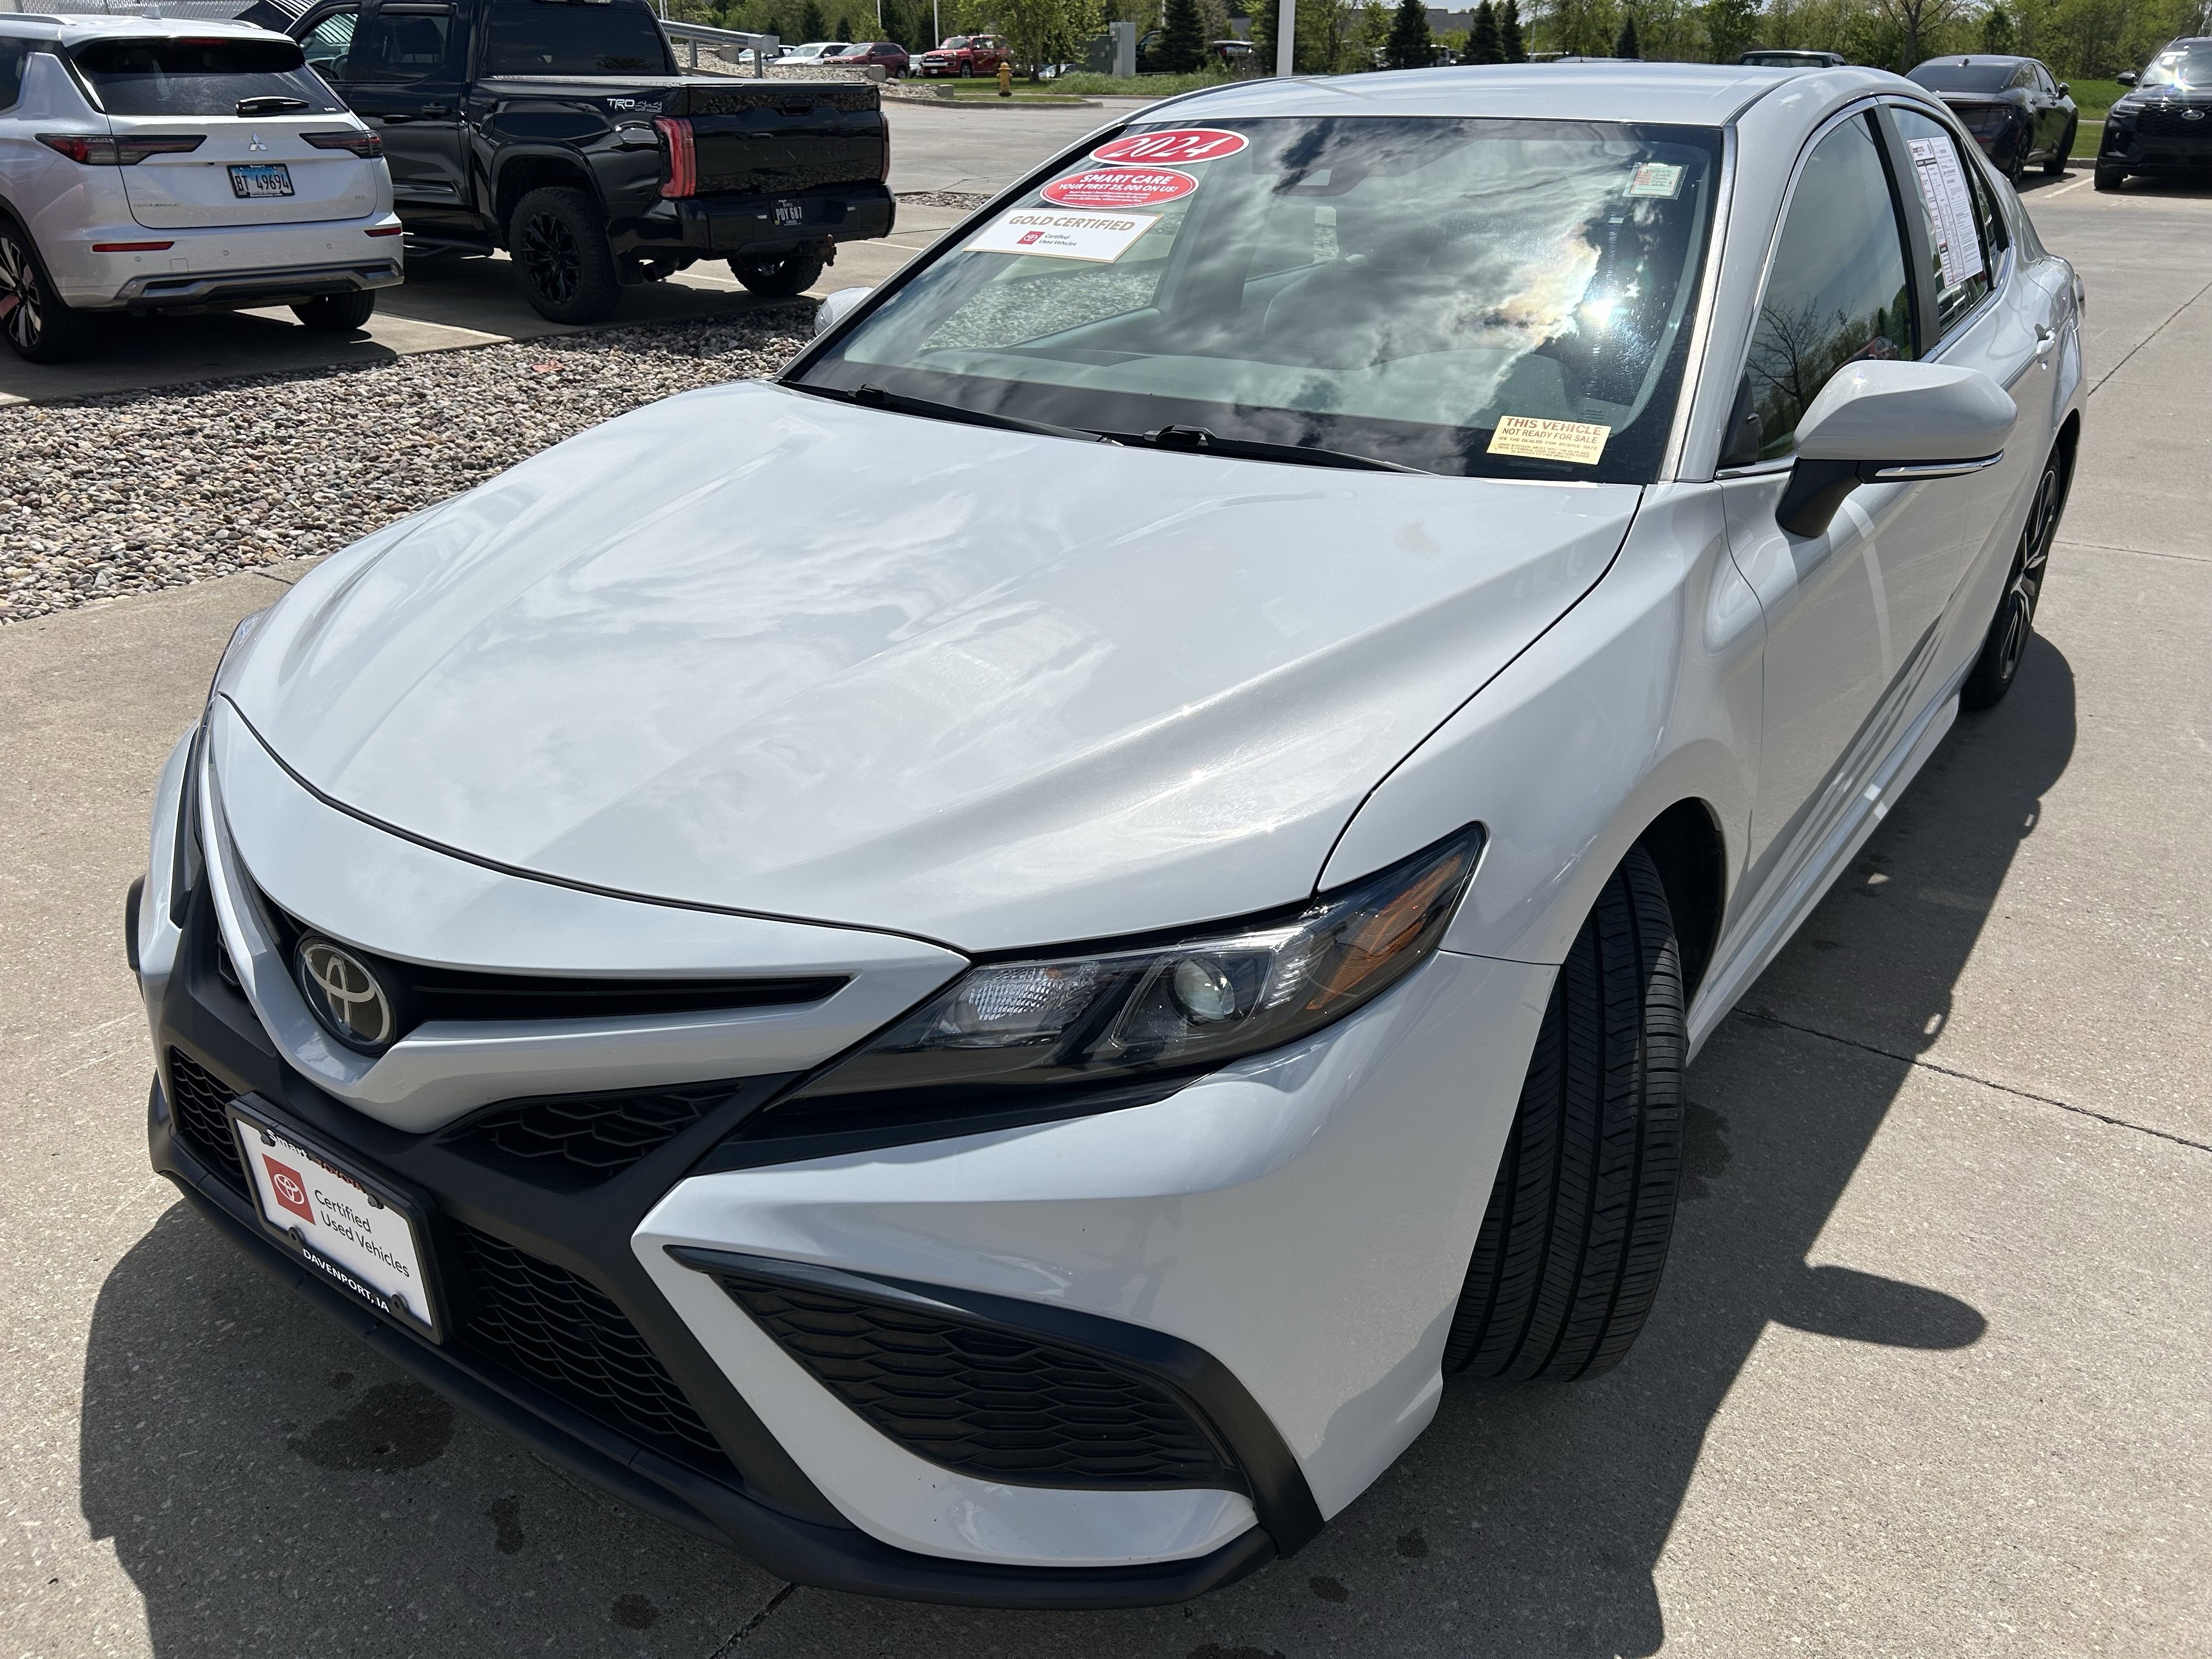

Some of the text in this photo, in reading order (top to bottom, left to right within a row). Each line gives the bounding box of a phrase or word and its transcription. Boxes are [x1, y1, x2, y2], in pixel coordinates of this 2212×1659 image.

[607, 98, 635, 109] TRD
[1102, 136, 1234, 157] 2024
[234, 174, 289, 191] BT 49694
[1080, 174, 1174, 184] SMART CARE
[789, 206, 802, 219] 687
[1009, 216, 1136, 231] GOLD CERTIFIED
[1507, 418, 1603, 436] THIS VEHICLE
[1522, 430, 1553, 439] READY
[1554, 432, 1572, 441] FOR
[1574, 435, 1598, 444] SALE
[267, 1129, 363, 1191] Smart TOYOTA
[314, 1189, 371, 1234] Certified
[320, 1210, 410, 1278] Used Vehicles
[303, 1248, 390, 1313] DAVENPORT, IA
